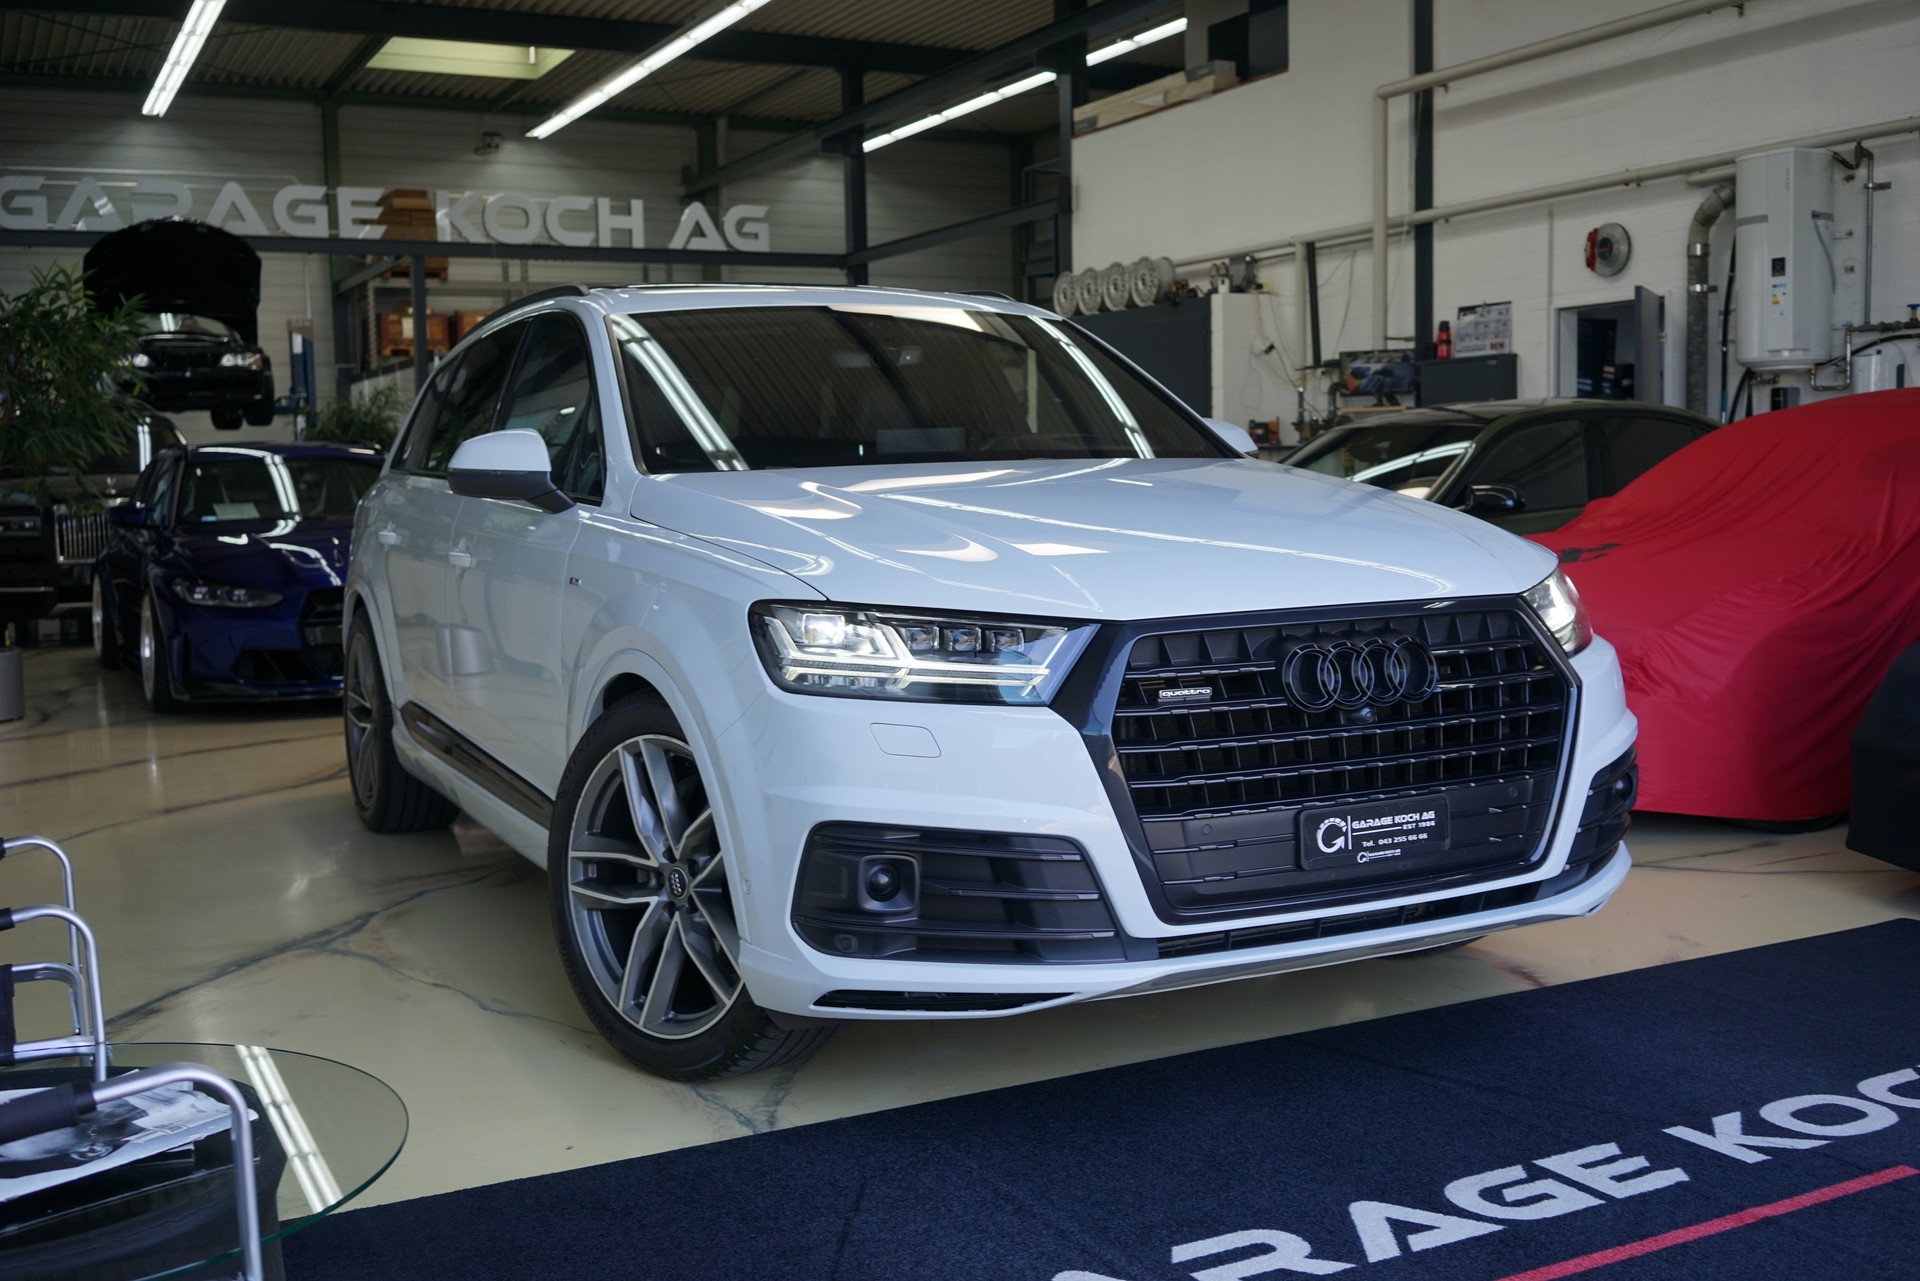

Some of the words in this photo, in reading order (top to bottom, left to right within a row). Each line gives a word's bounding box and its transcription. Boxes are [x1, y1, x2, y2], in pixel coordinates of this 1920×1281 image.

[0, 175, 387, 239] GARAGE
[435, 190, 644, 249] KOCH
[668, 202, 769, 251] AG
[1162, 689, 1211, 697] quattro
[1352, 816, 1394, 829] GARAGE
[1394, 812, 1420, 823] KOCH
[1421, 810, 1435, 819] AG
[1378, 837, 1393, 846] 043
[1393, 835, 1407, 843] 255
[1418, 832, 1428, 840] 66
